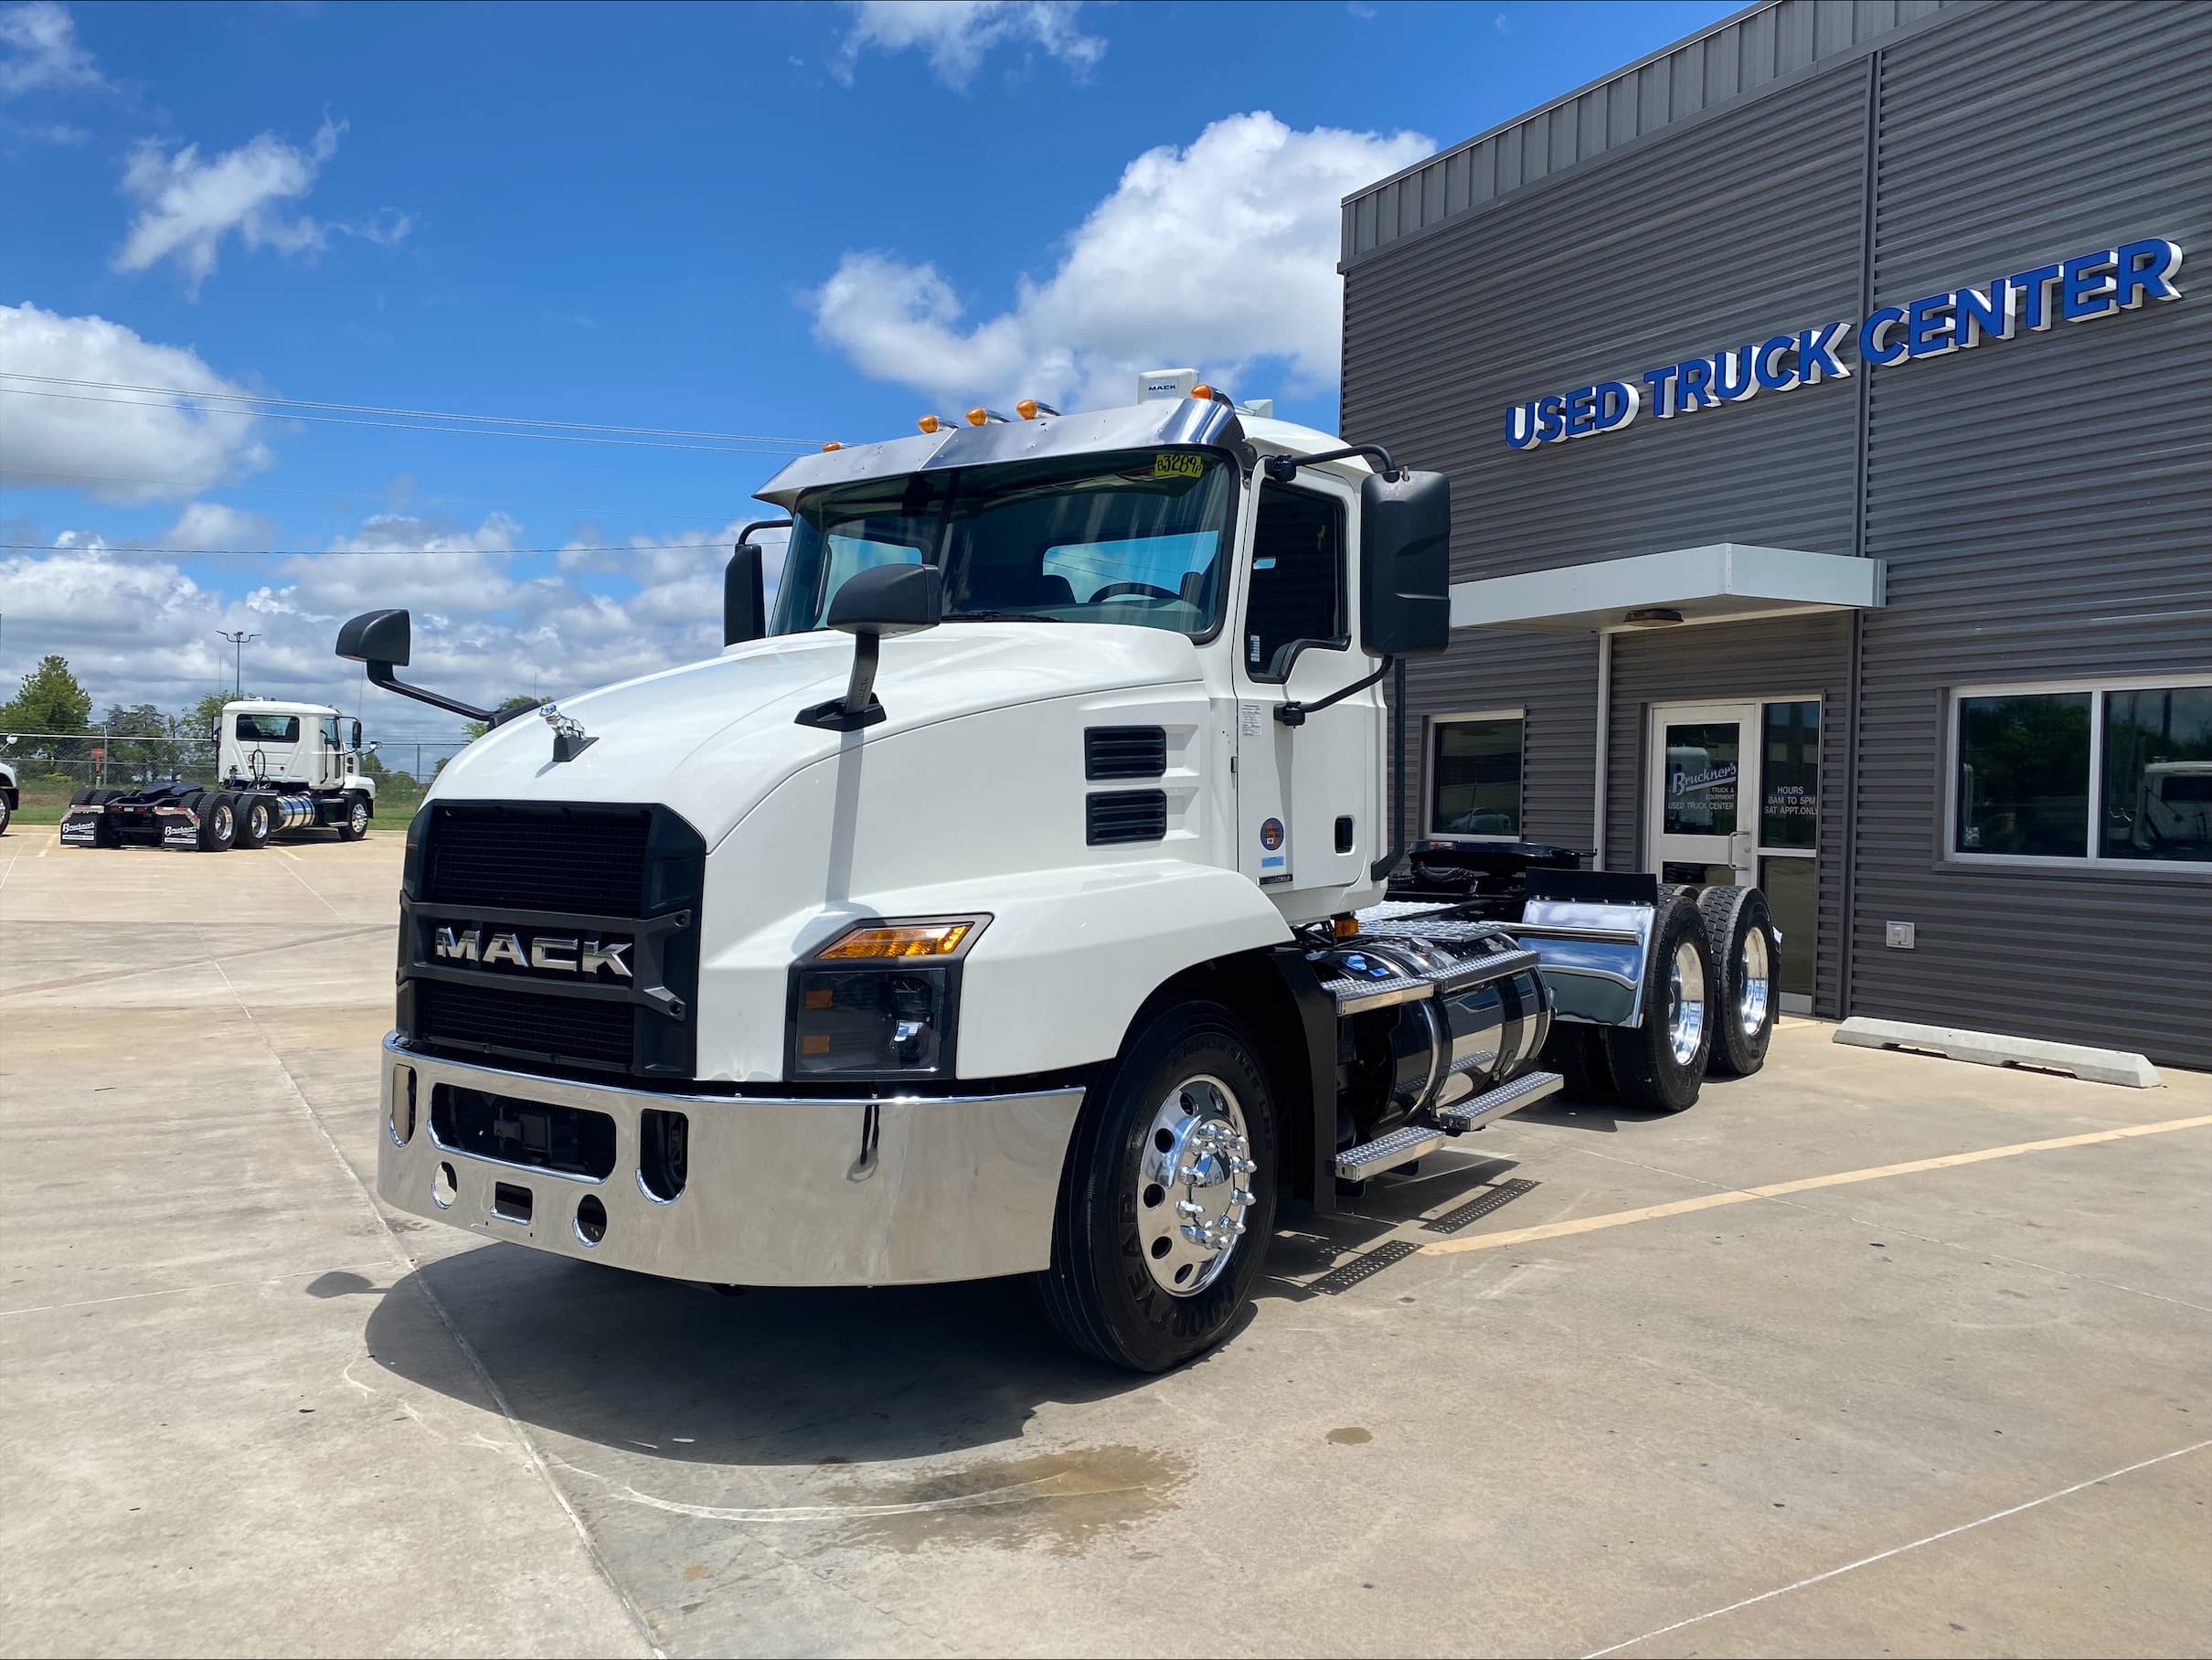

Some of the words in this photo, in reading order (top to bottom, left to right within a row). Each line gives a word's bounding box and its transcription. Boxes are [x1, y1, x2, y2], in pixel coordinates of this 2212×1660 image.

[1505, 381, 1640, 450] USED
[1643, 322, 1852, 419] TRUCK
[1858, 238, 2184, 367] CENTER
[1672, 762, 1737, 796] Bruckner's
[1777, 786, 1804, 794] HOURS
[1768, 796, 1784, 804] 8AM
[1787, 796, 1797, 804] TO
[1800, 796, 1816, 804] 5PM
[1668, 802, 1684, 810] USED
[1686, 802, 1707, 810] TRUCK
[1708, 802, 1734, 810] CENTER
[1764, 805, 1777, 814] SAT
[435, 926, 633, 977] MACK
